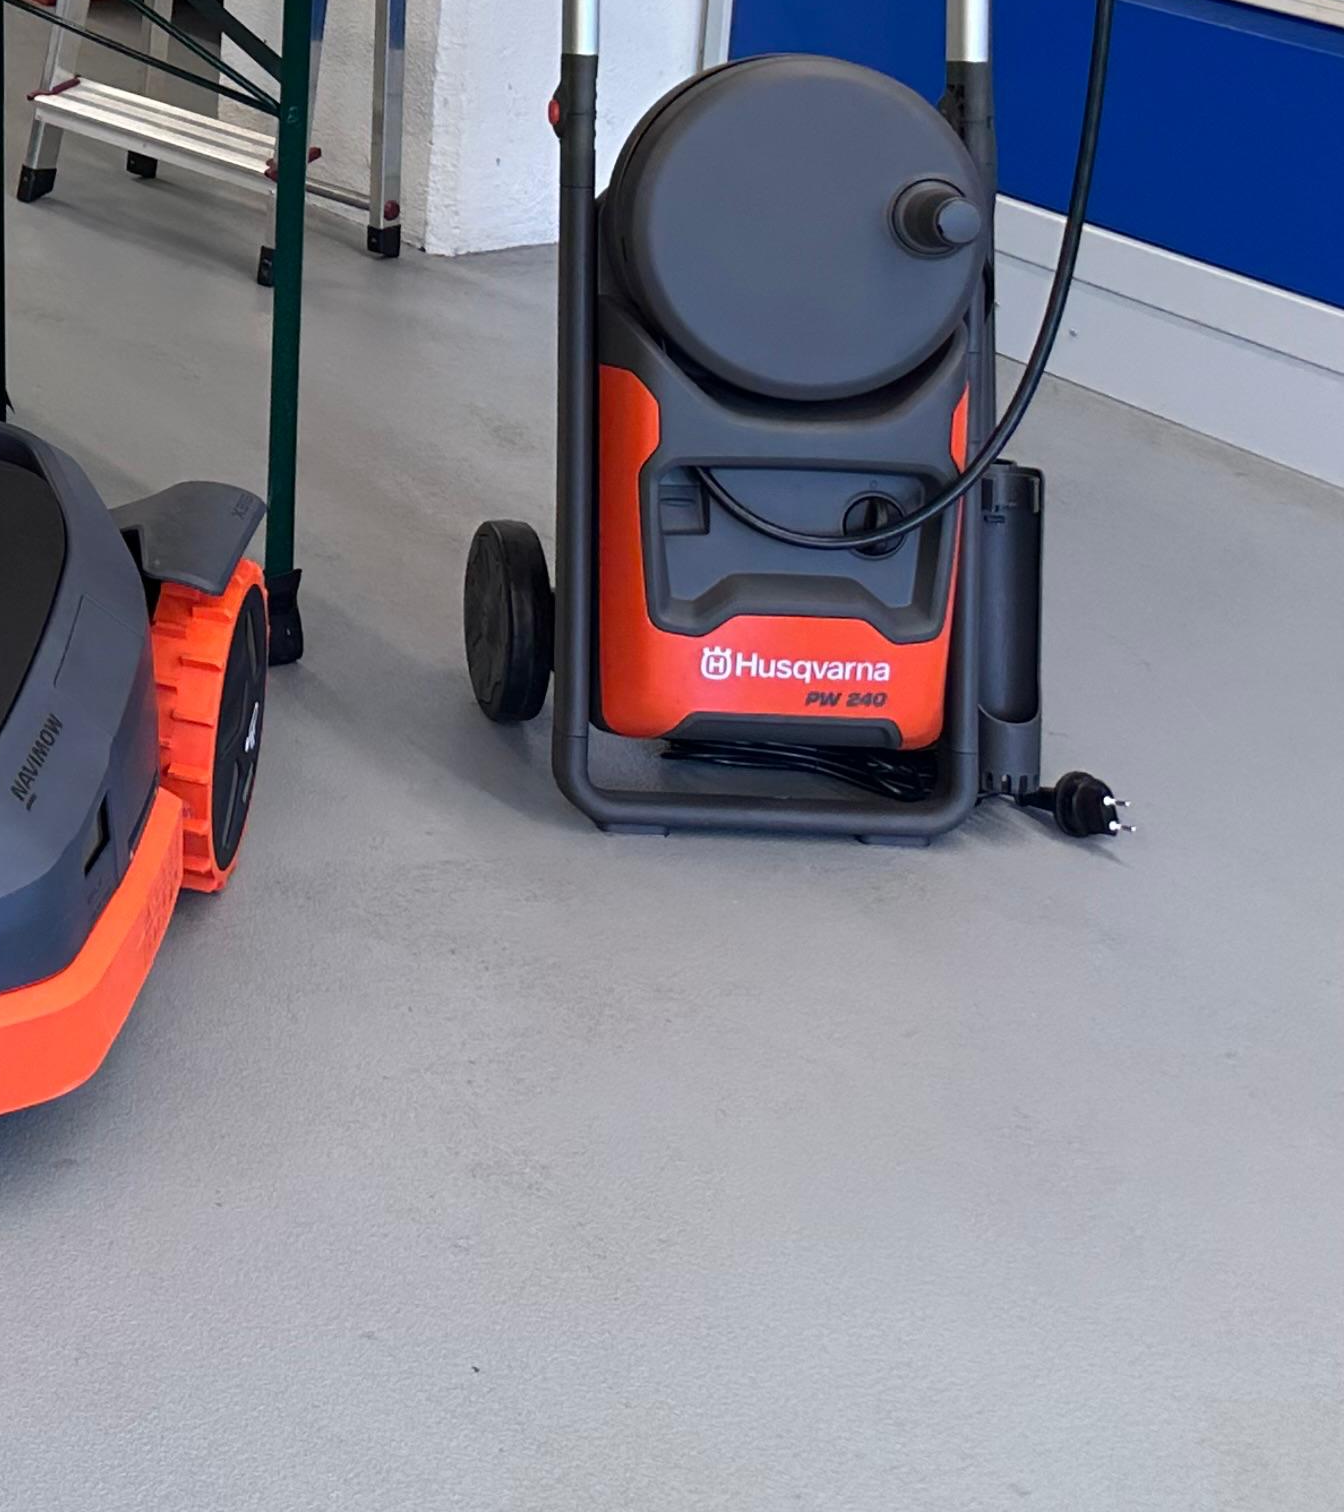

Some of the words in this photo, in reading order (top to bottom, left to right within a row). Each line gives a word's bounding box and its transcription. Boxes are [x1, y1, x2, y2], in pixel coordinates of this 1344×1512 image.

[734, 651, 891, 685] Husqvarna
[804, 690, 842, 709] PW
[846, 690, 888, 708] 240
[10, 712, 64, 802] NAVIMOW
